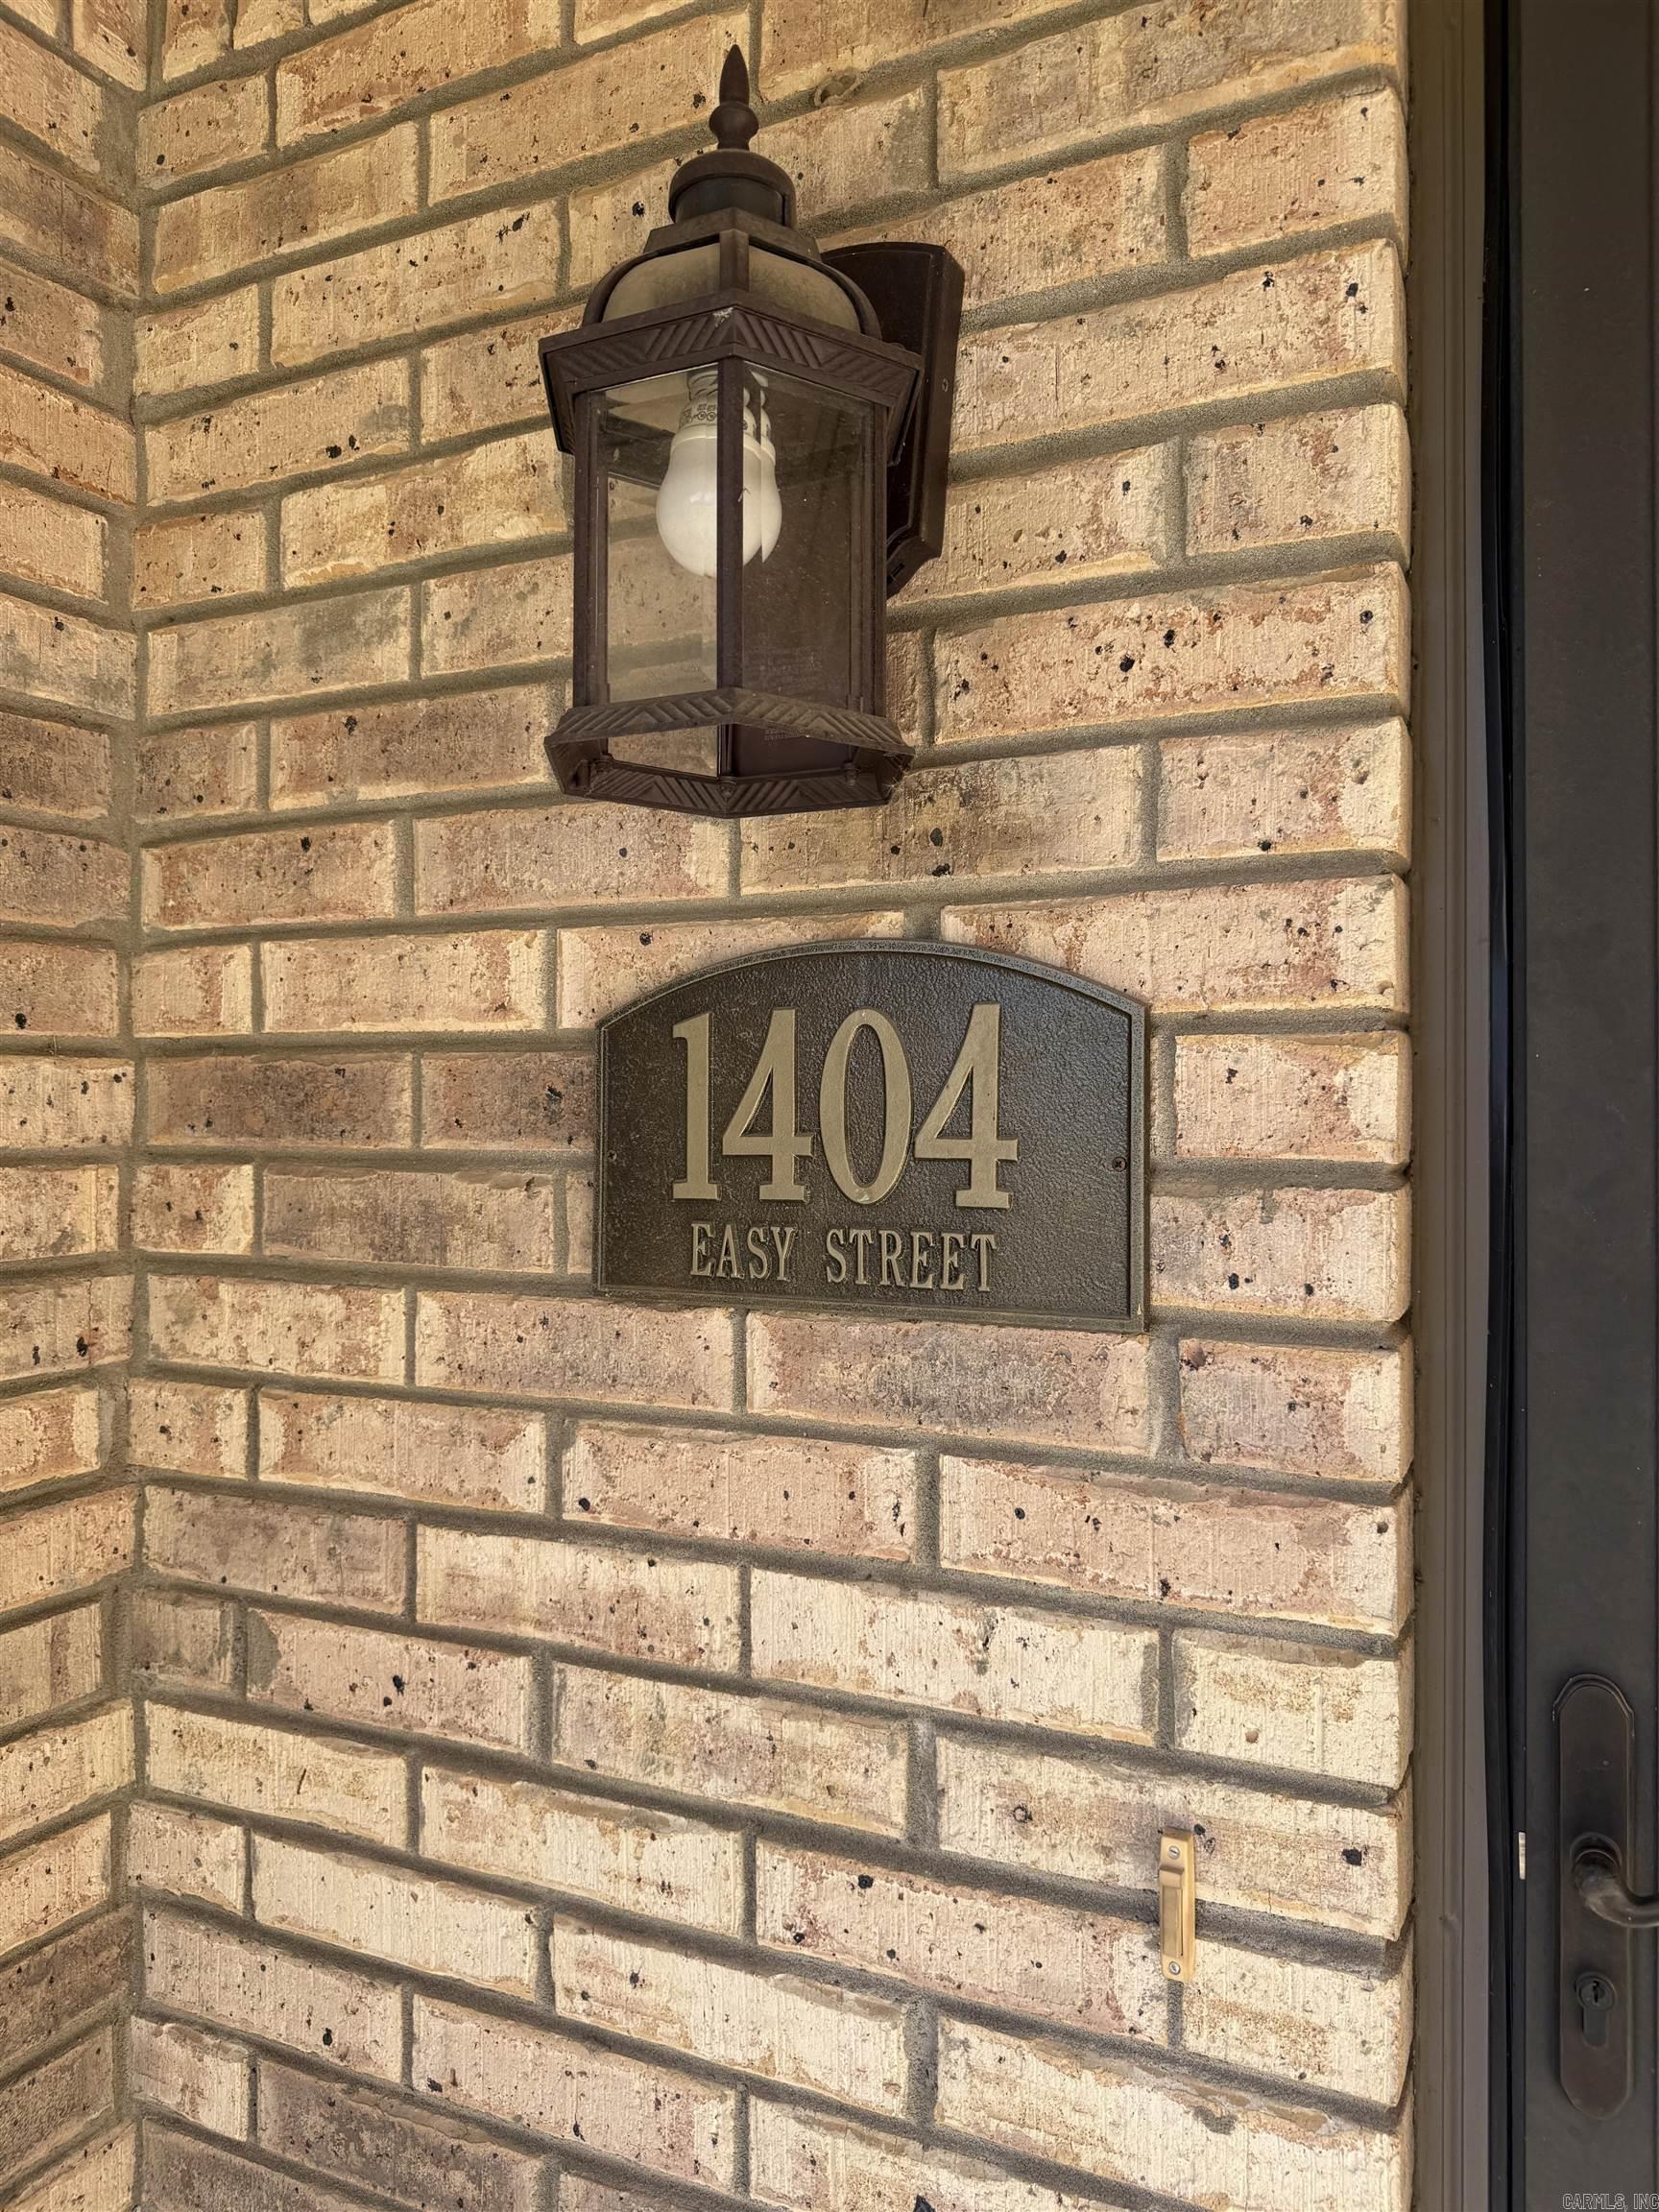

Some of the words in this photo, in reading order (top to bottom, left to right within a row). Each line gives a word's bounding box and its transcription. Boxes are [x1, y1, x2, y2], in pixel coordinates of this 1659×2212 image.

[672, 1002, 1019, 1209] 1404
[689, 1222, 796, 1281] EASY
[826, 1228, 998, 1292] STREET
